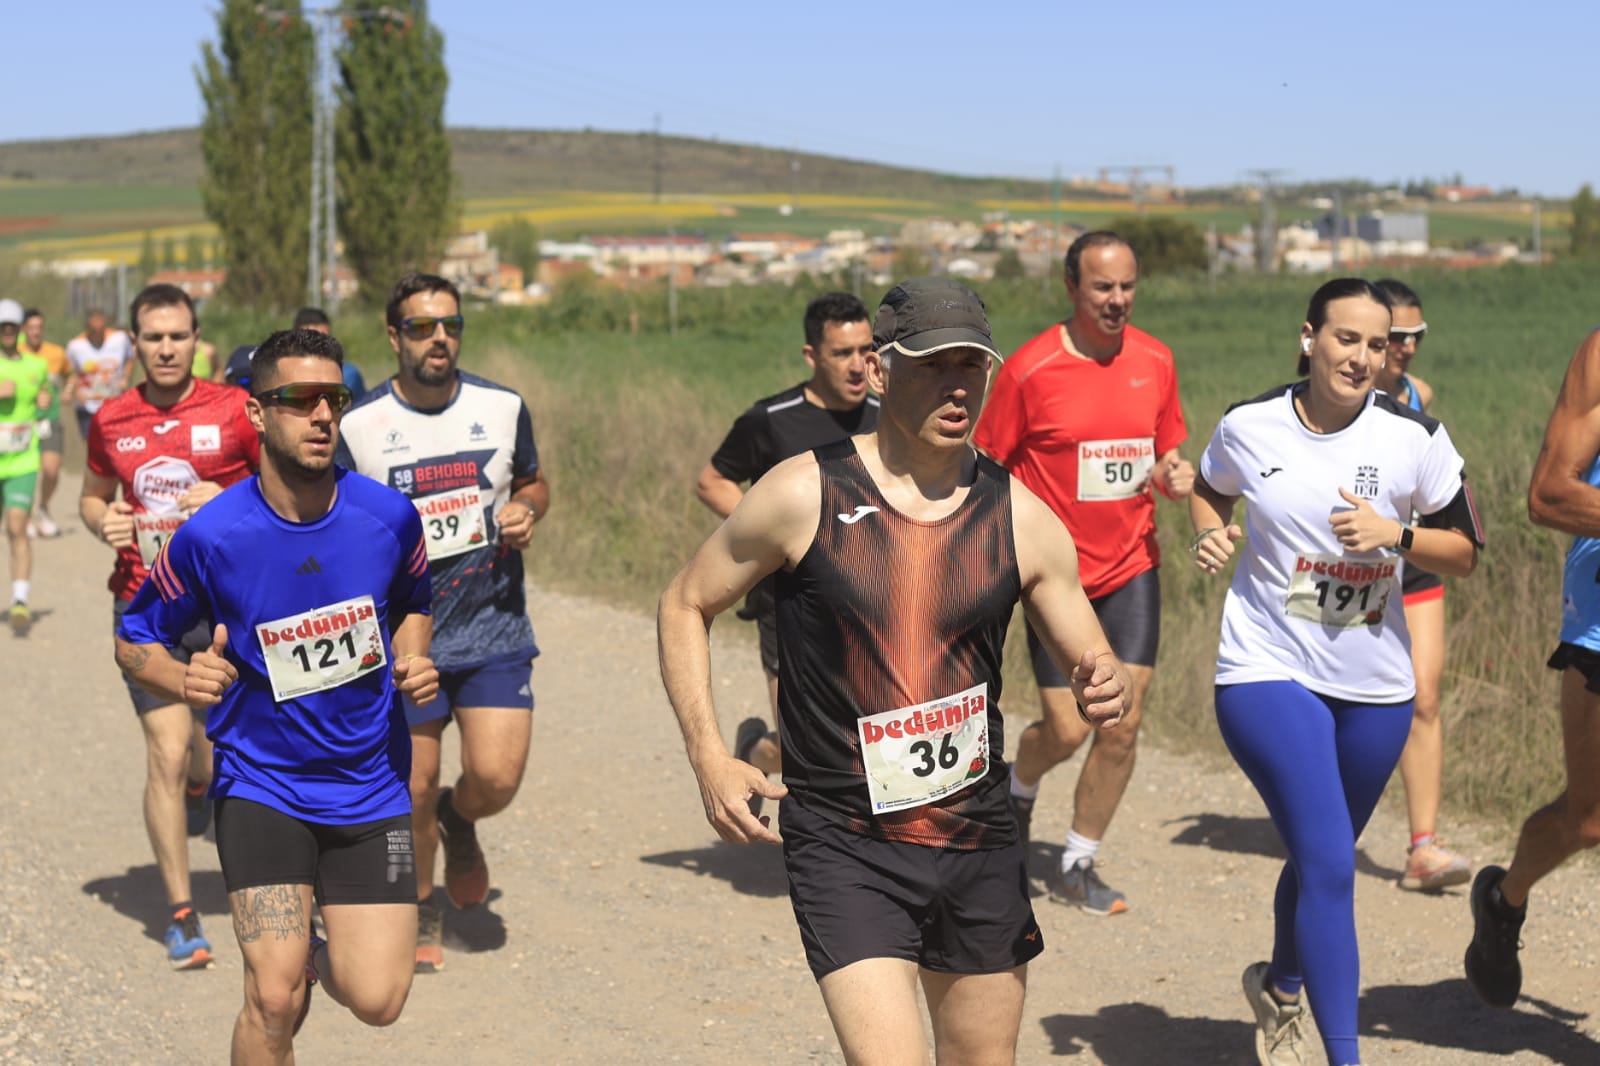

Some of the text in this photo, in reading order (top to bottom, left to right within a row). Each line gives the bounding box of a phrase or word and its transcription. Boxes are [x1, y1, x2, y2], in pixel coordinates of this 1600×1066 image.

[1082, 444, 1152, 459] bedunia
[144, 474, 192, 490] PONLE
[394, 461, 478, 486] 58 BEHOBIA
[1105, 462, 1133, 483] 50
[419, 493, 478, 516] dunia
[137, 517, 186, 531] bedu
[429, 515, 459, 540] 39
[1296, 557, 1395, 581] bedunia
[1315, 580, 1372, 611] 191
[261, 605, 373, 646] bedunia
[292, 631, 356, 672] 121
[863, 695, 985, 744] bedunia
[910, 732, 959, 777] 36
